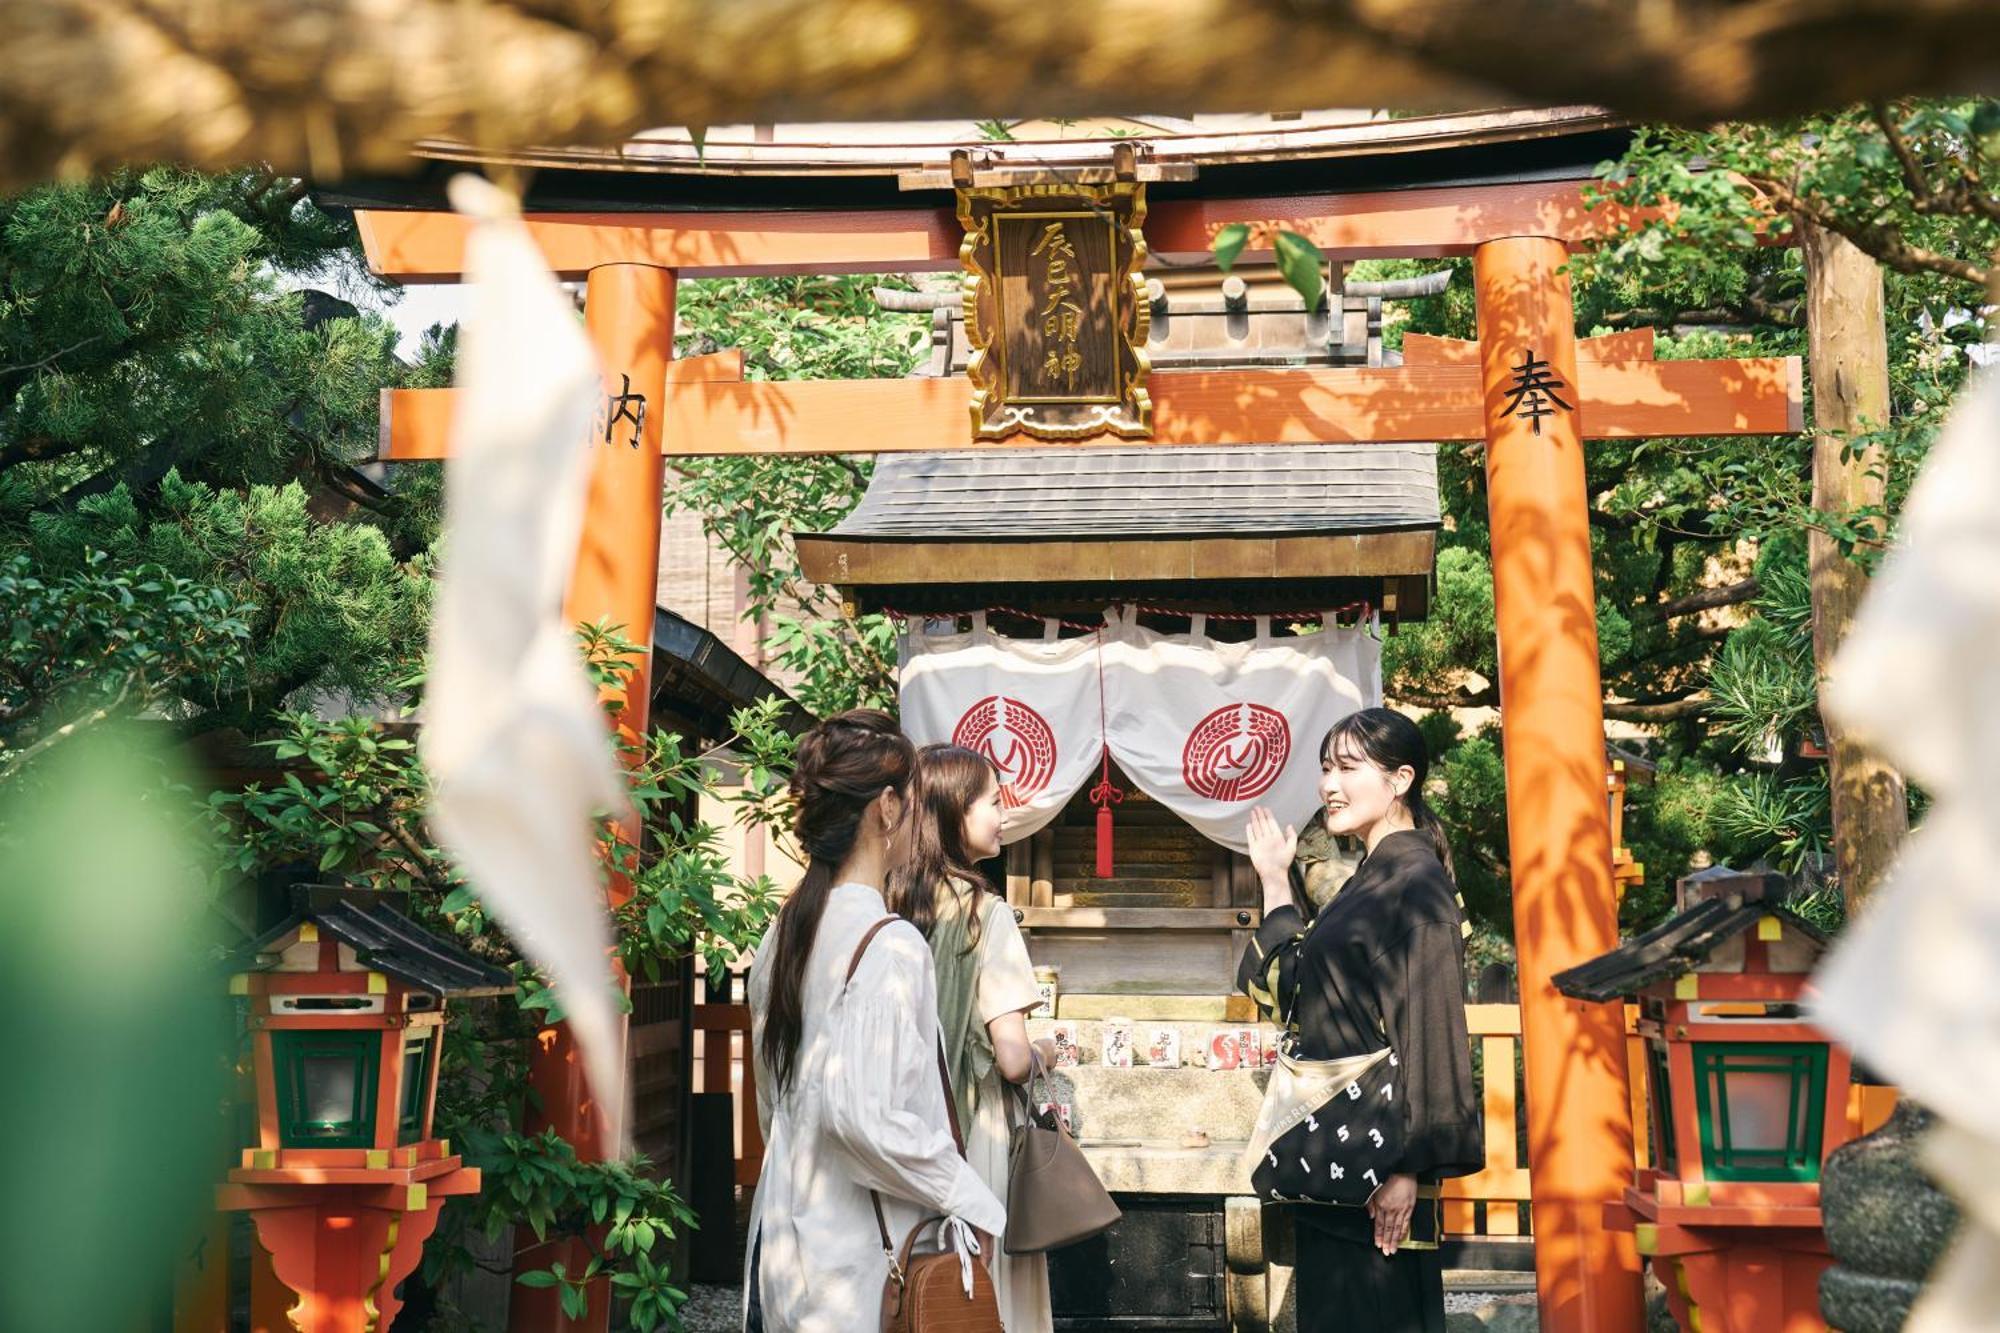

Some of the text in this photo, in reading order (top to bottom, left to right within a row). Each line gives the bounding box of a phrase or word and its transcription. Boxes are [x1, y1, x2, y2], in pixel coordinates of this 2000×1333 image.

[1500, 350, 1574, 436] 奉
[1305, 1114, 1319, 1132] 2
[1337, 1124, 1349, 1142] 5
[1368, 1128, 1384, 1148] 3
[1330, 1162, 1344, 1179] 4
[1362, 1168, 1378, 1186] 7
